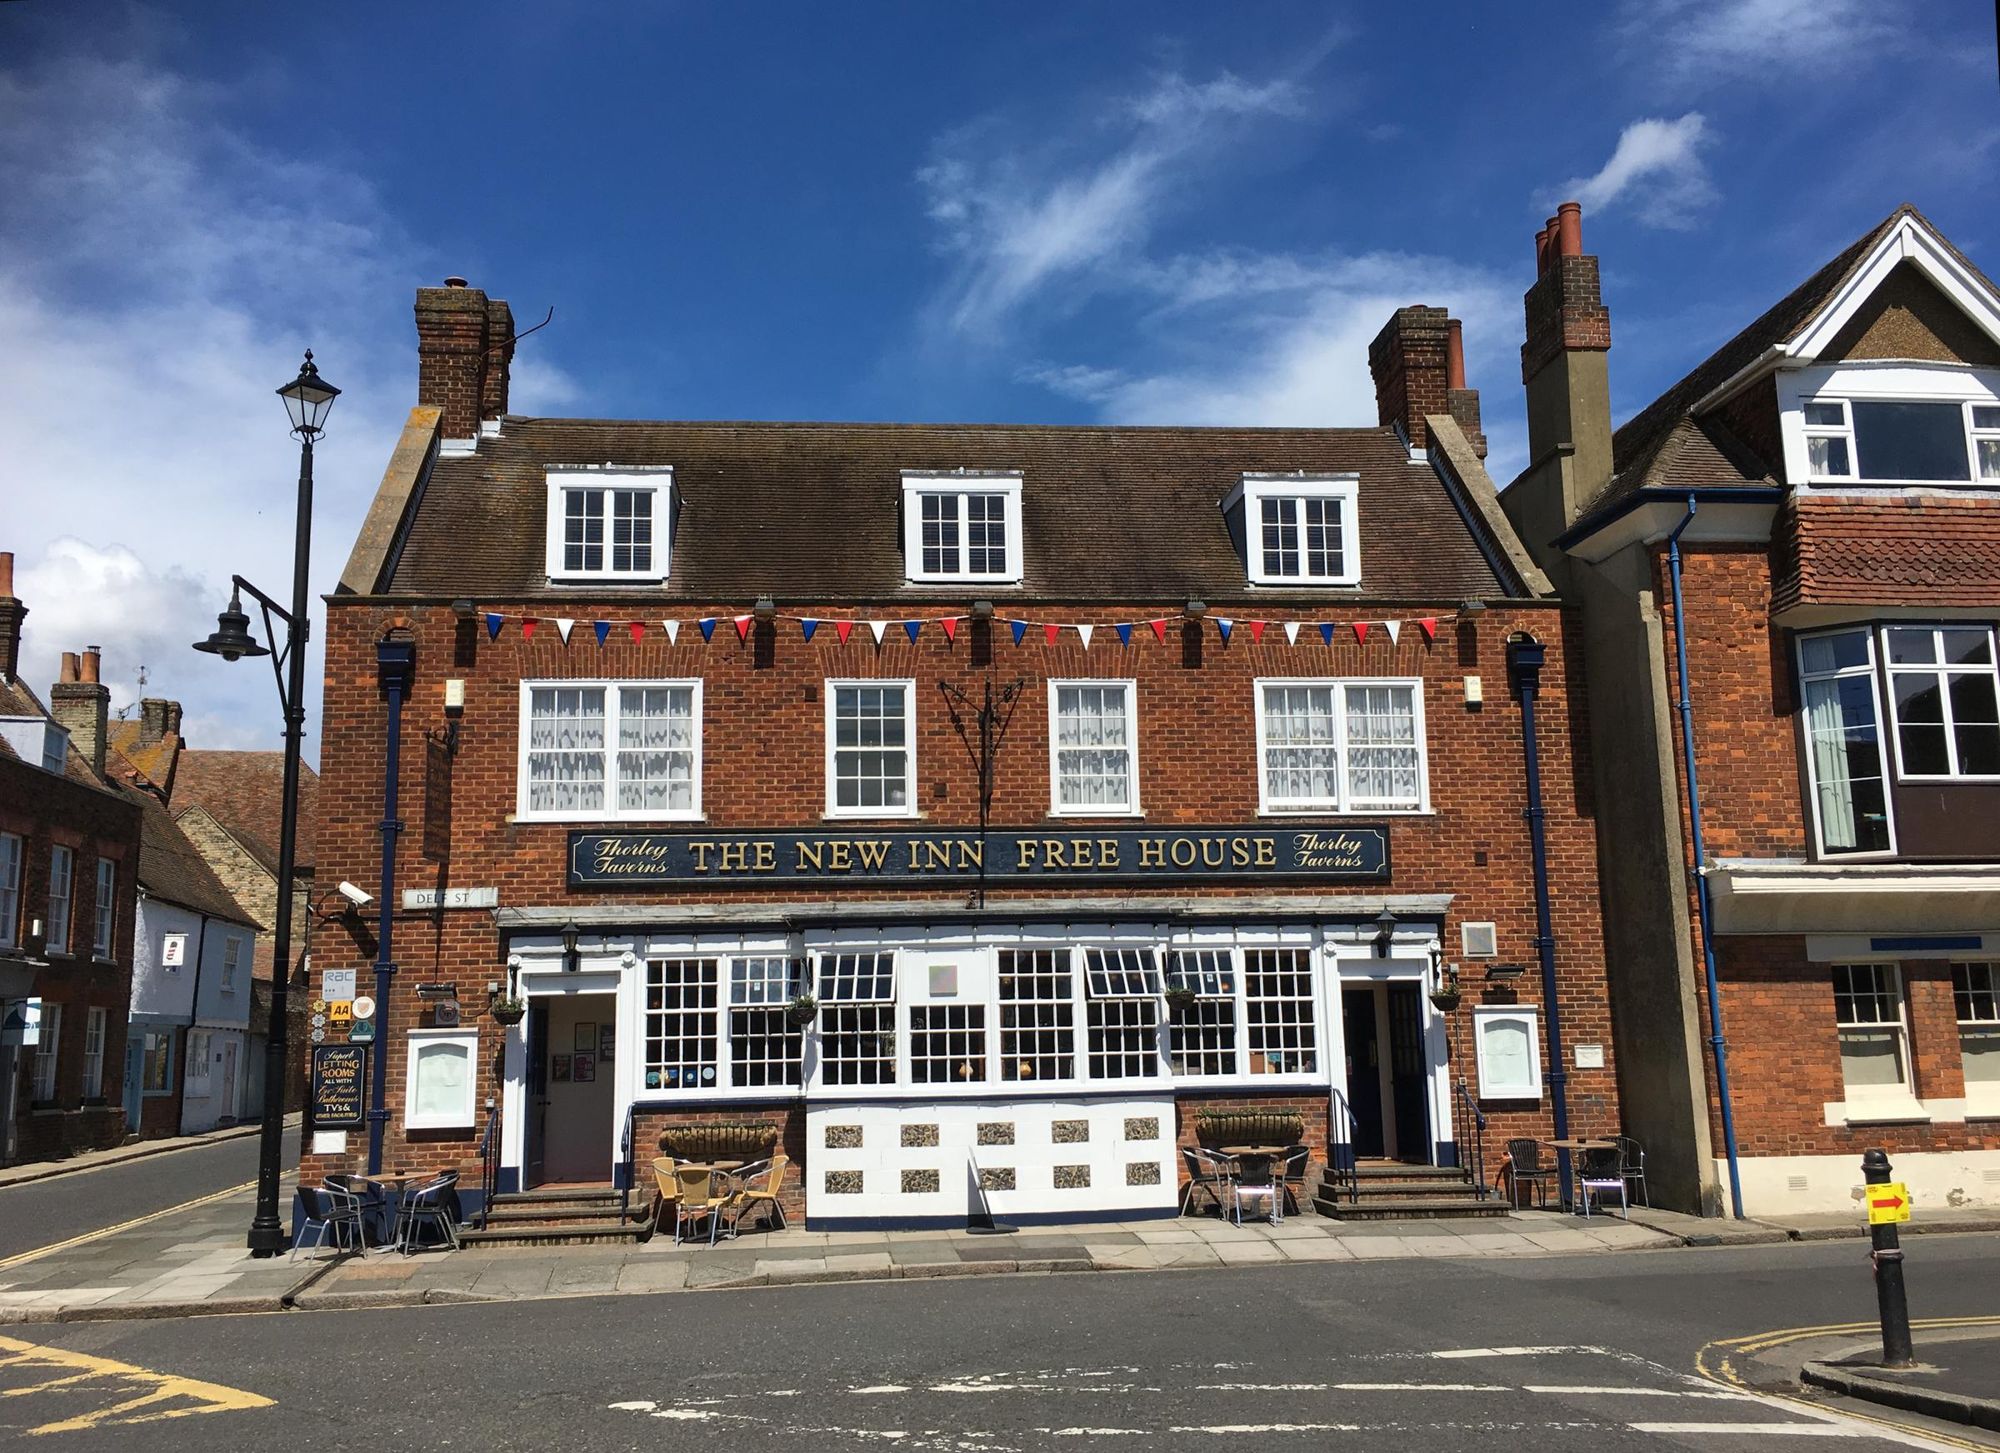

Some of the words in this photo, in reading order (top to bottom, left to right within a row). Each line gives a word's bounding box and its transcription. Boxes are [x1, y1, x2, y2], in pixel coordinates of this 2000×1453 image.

[594, 839, 669, 861] Thorley
[1293, 833, 1362, 855] Thorley
[689, 841, 776, 871] THE
[795, 840, 892, 870] NEW
[908, 840, 984, 869] INN
[1016, 839, 1120, 868] FREE
[1137, 837, 1277, 867] HOUSE
[1293, 850, 1363, 867] Taverns
[593, 856, 669, 873] Taverns
[416, 893, 447, 904] DELF
[455, 893, 470, 903] ST
[334, 1005, 349, 1016] AA
[324, 1049, 355, 1061] Superb
[317, 1060, 359, 1071] LETTING
[322, 1068, 355, 1078] ROOMS
